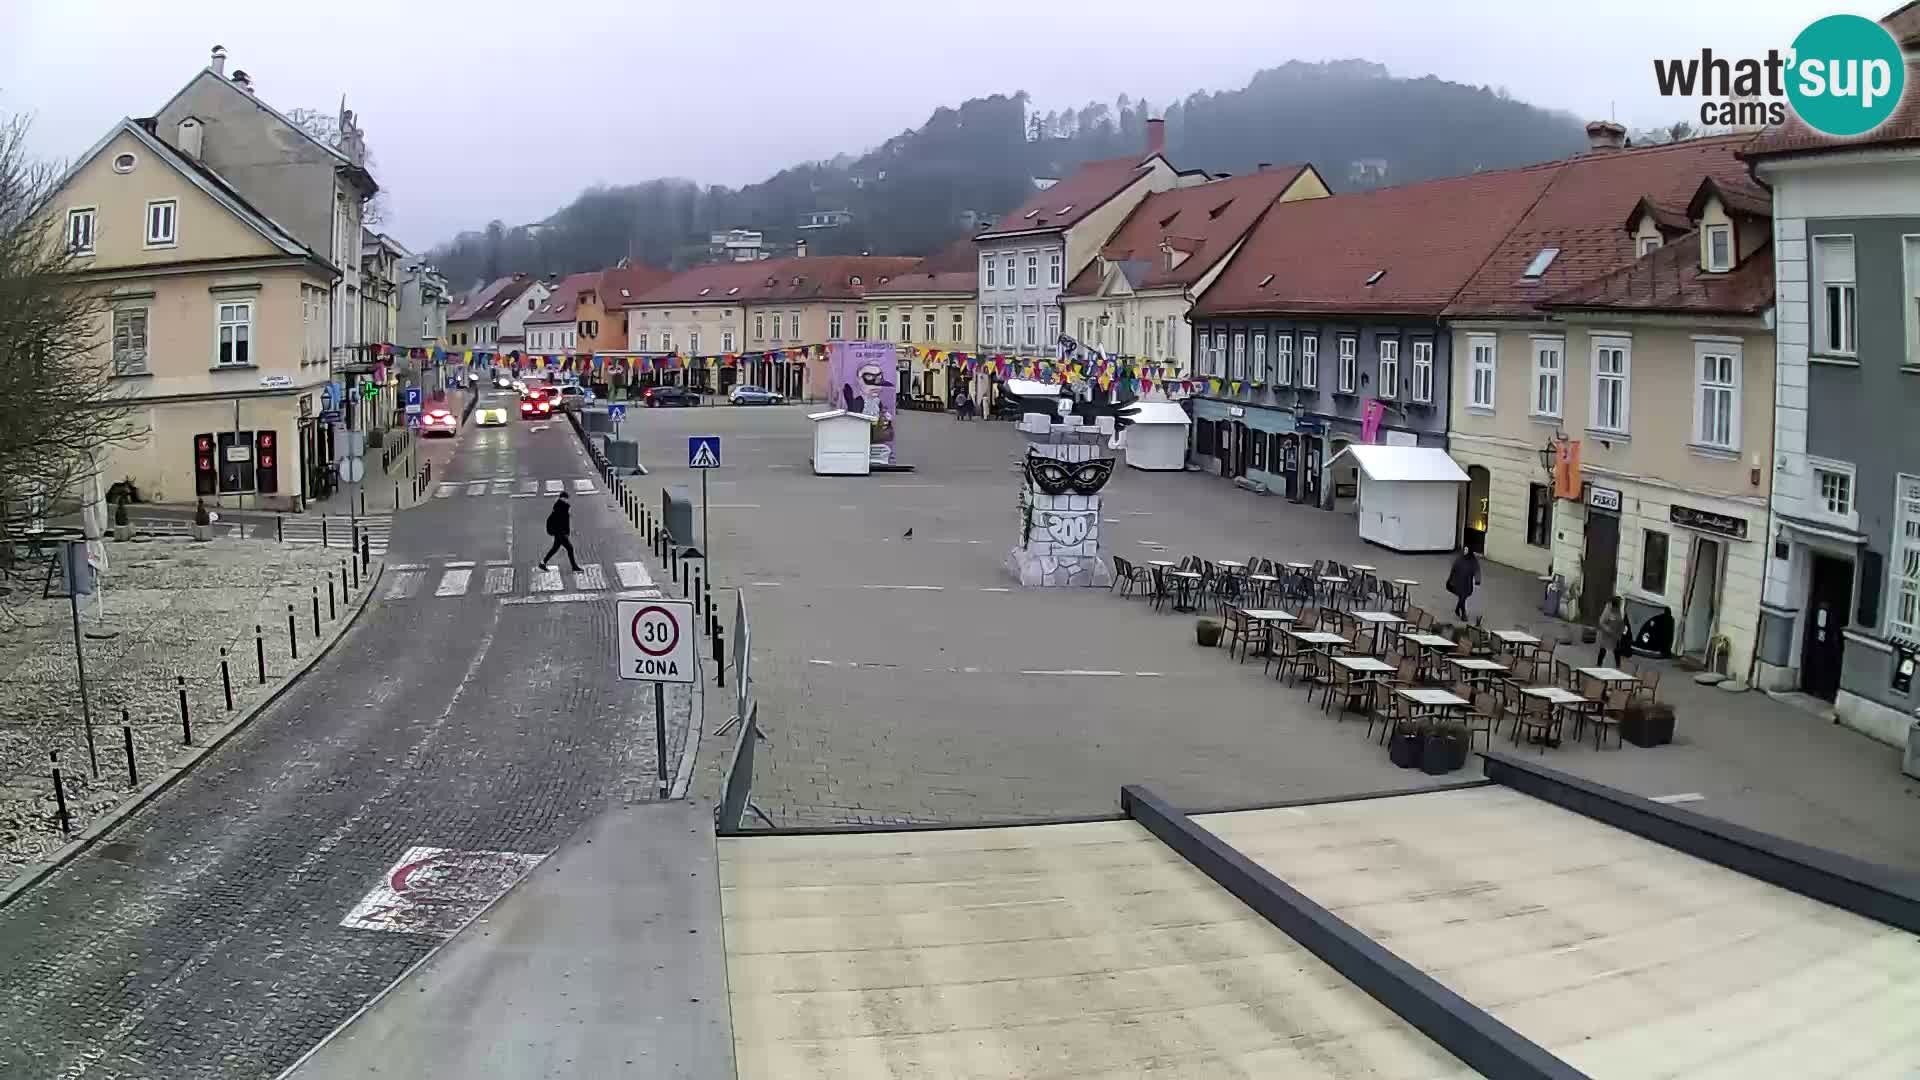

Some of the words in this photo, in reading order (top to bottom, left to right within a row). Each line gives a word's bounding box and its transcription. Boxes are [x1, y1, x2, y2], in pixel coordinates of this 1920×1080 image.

[409, 391, 417, 403] P
[1048, 516, 1087, 546] 200
[644, 621, 668, 643] 30
[635, 659, 678, 676] ZONA
